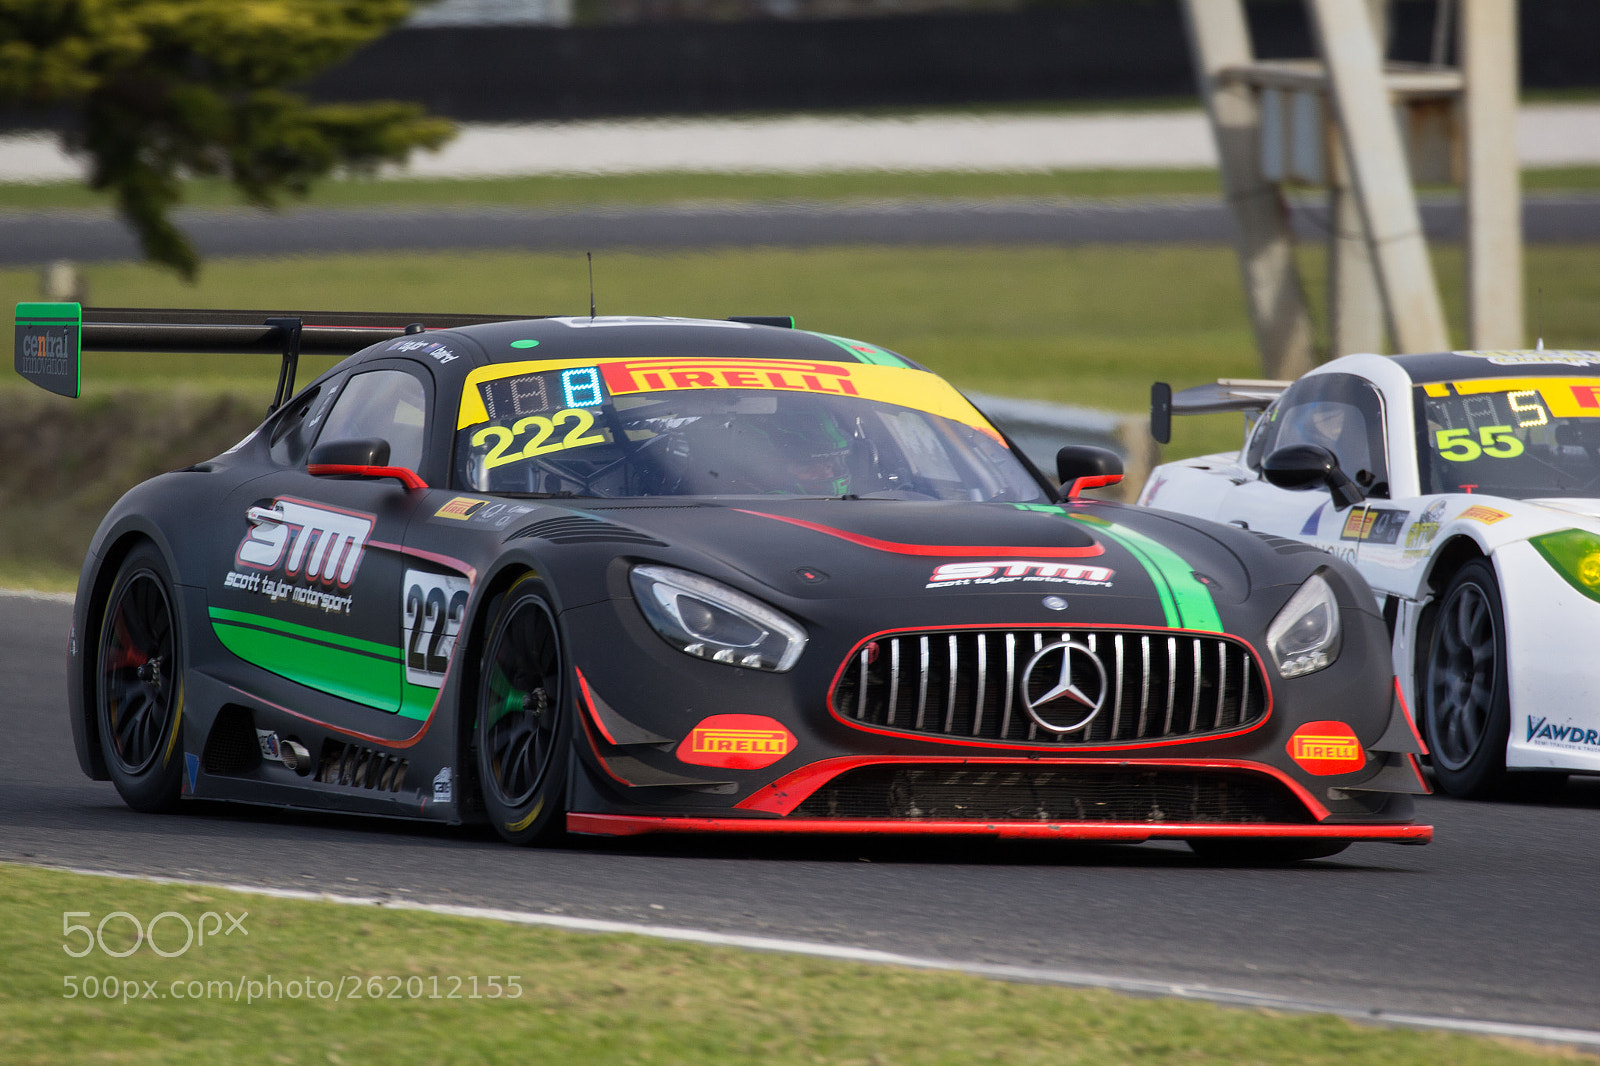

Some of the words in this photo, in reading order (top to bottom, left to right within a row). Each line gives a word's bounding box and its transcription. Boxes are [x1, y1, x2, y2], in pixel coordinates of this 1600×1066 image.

[597, 358, 860, 396] PIRELLI
[472, 408, 605, 470] 222
[1436, 425, 1525, 462] 55
[224, 571, 260, 592] scott
[261, 575, 293, 600] taylor
[292, 585, 352, 613] motorsport
[925, 578, 970, 589] scott
[974, 576, 1022, 585] taylor
[1023, 576, 1114, 588] motorsport
[693, 729, 787, 754] PIRELLI
[1294, 736, 1358, 760] PIRELLI
